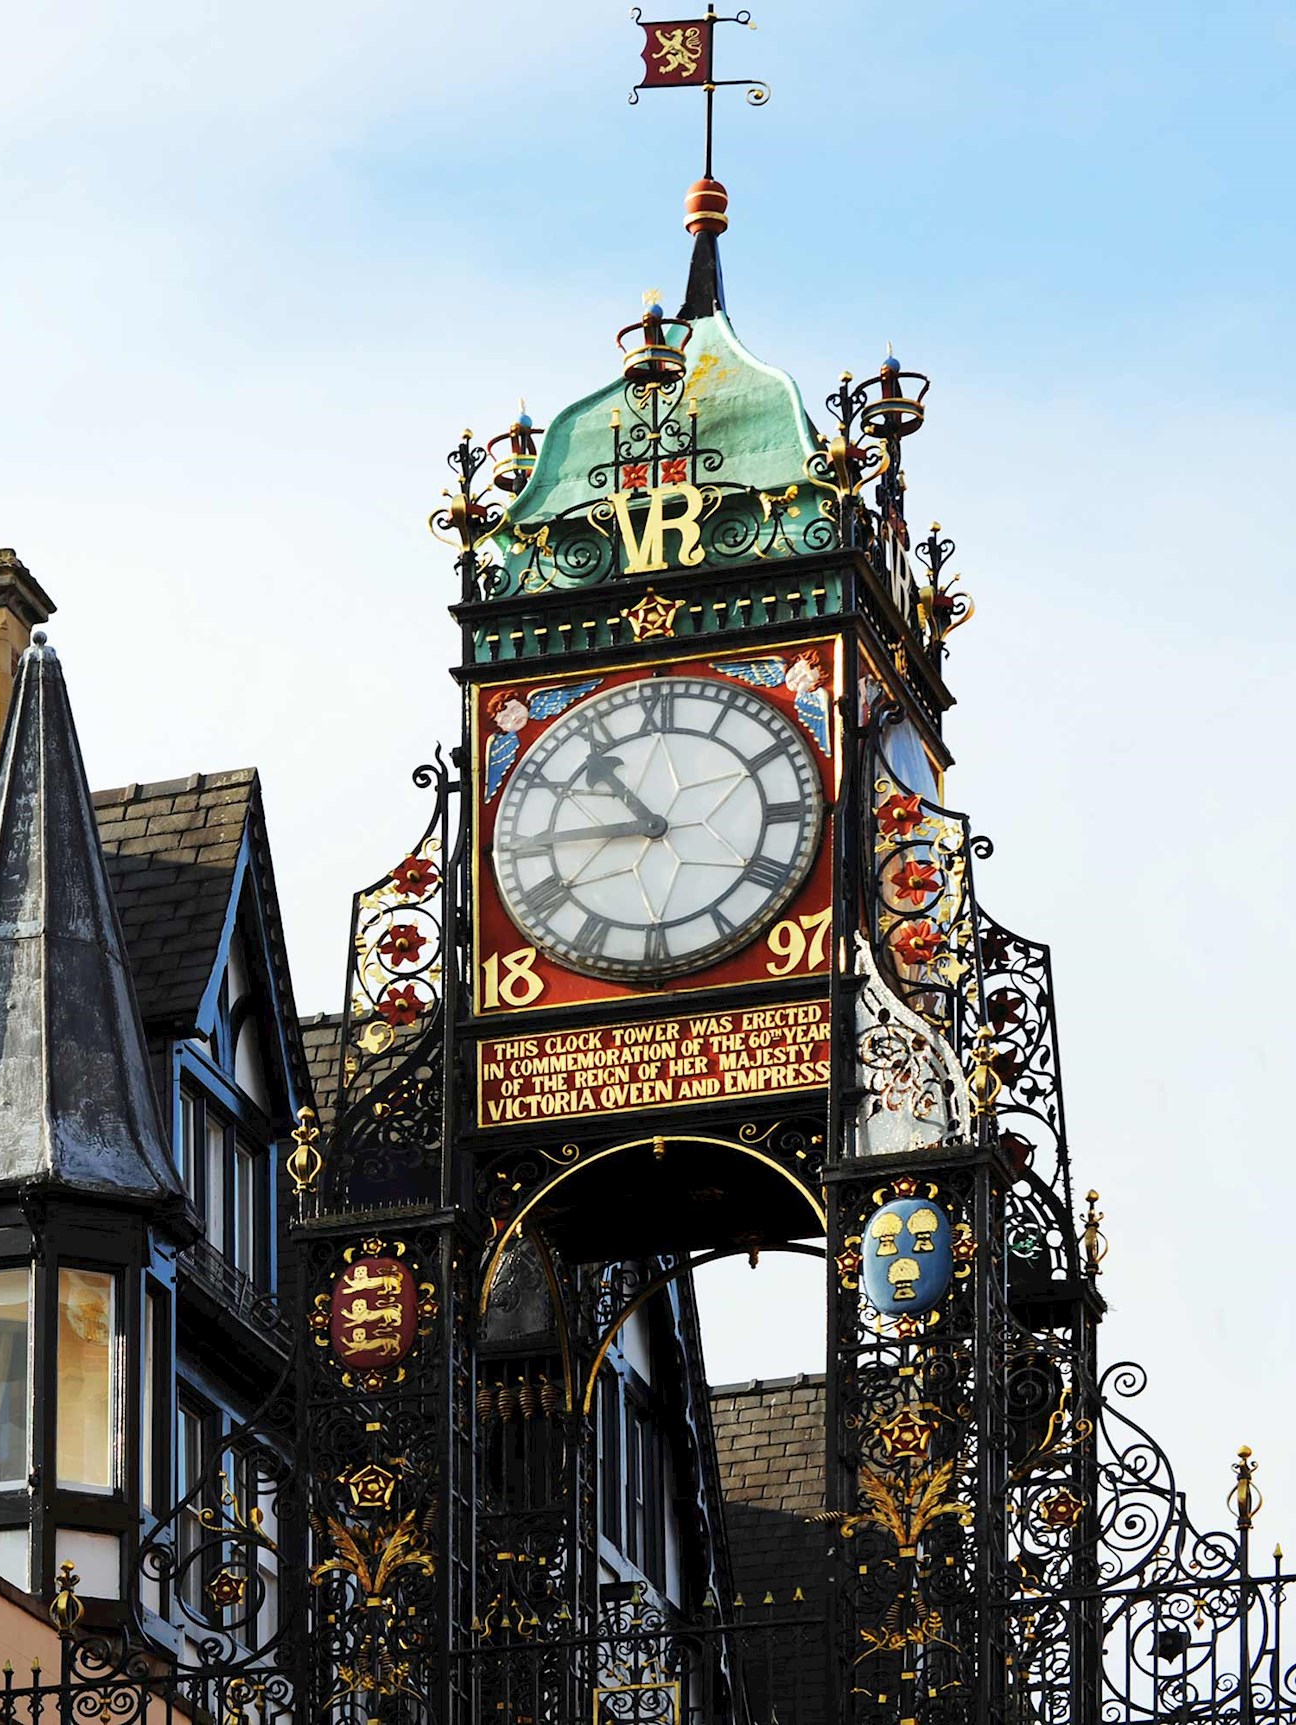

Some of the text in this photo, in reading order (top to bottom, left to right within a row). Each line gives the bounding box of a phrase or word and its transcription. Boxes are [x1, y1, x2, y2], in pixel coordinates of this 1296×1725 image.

[607, 484, 706, 575] VR
[638, 693, 674, 733] XII
[749, 740, 787, 772] II
[528, 771, 568, 798] X
[764, 801, 802, 825] III
[744, 855, 790, 891] IIII
[709, 906, 737, 939] V
[481, 905, 833, 1009] 18 97
[644, 926, 671, 961] VI
[483, 1062, 504, 1081] IN
[510, 1041, 676, 1077] COMMEMORATION
[681, 1038, 704, 1056] OF
[709, 1033, 746, 1053] THE
[783, 1023, 831, 1044] YEAR
[494, 1005, 822, 1061] THIS CLOCK TOWER WAS ERECTED
[501, 1043, 814, 1097] OF THE REIGN OF HER MAJESTY
[600, 1079, 673, 1109] QVEEN
[678, 1078, 721, 1099] AND
[724, 1060, 831, 1094] EMPRESS
